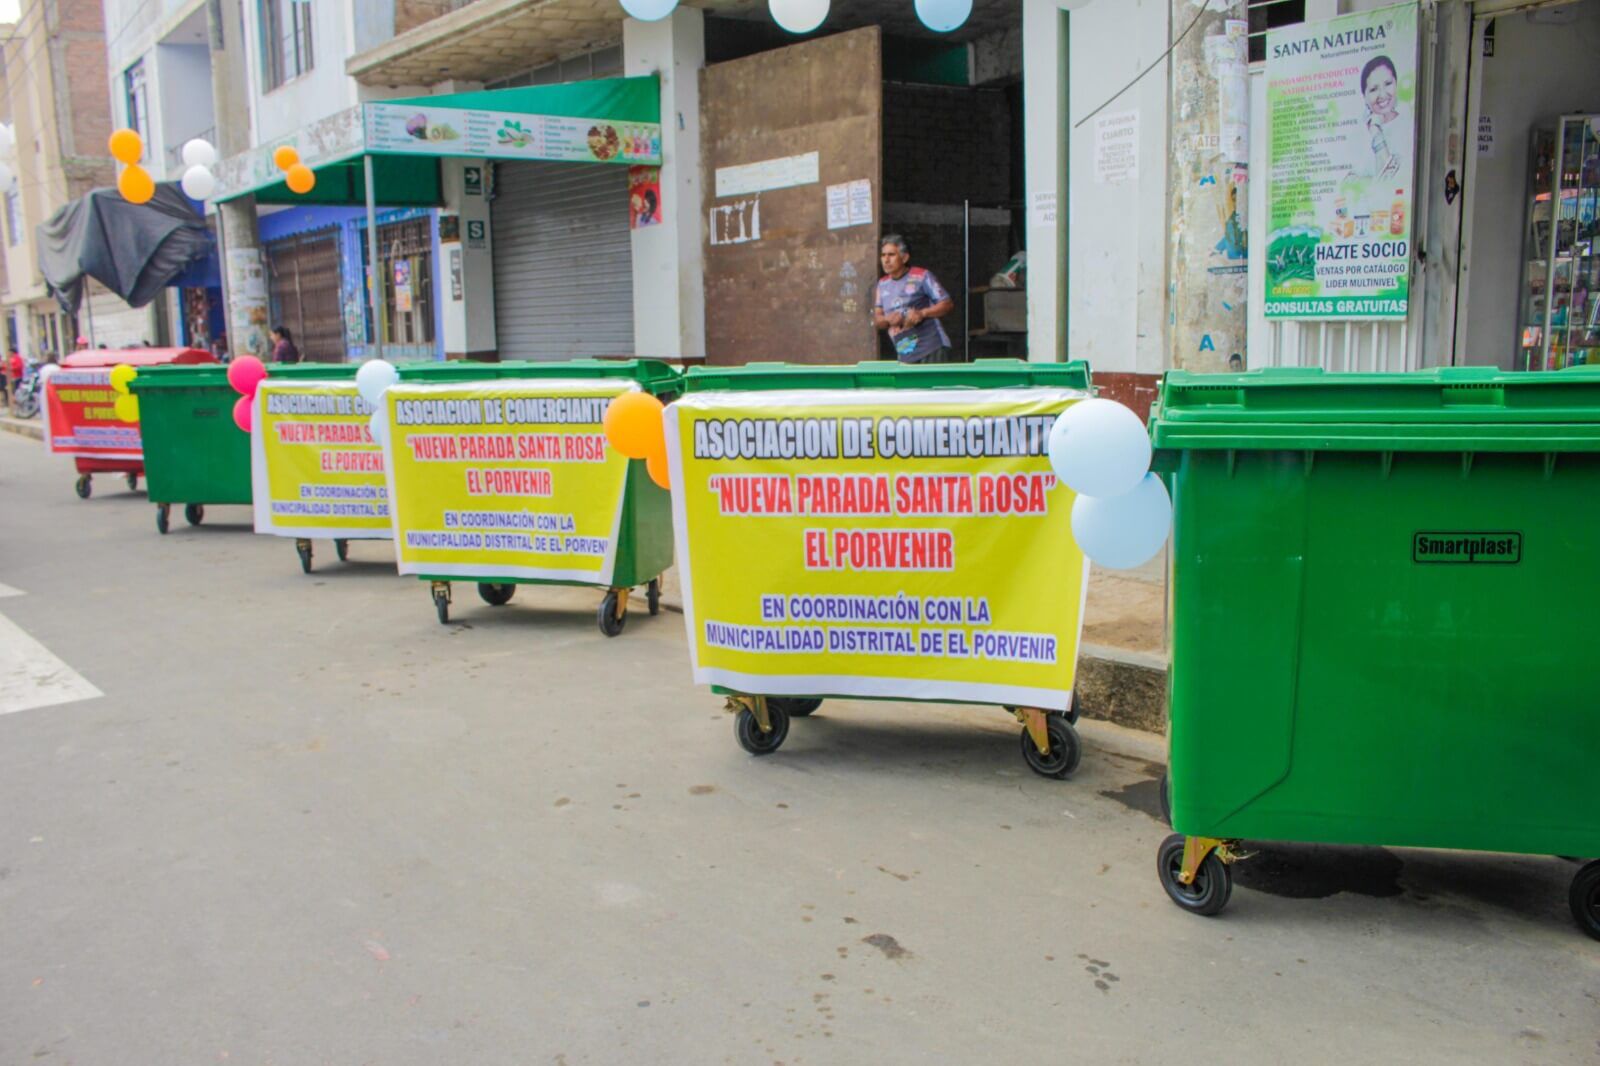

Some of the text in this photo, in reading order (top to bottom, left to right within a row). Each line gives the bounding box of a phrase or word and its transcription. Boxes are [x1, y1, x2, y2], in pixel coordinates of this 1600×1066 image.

[1273, 25, 1386, 59] SANTA NATURA
[471, 222, 483, 238] S
[1316, 242, 1407, 260] HAZTE SOCIO
[1316, 266, 1344, 276] VENTAS
[1346, 265, 1361, 274] POR
[1350, 278, 1396, 288] MULTINIVEL
[1264, 300, 1407, 313] CONSULTAS GRATUITAS
[396, 399, 482, 425] ASOCIACION
[484, 399, 503, 424] DE
[318, 423, 363, 443] PARADA
[694, 418, 838, 459] ASOCIACION
[841, 417, 873, 458] DE
[460, 435, 514, 460] PARADA
[518, 435, 561, 460] SANTA
[322, 452, 333, 471] EL
[301, 486, 311, 497] EN
[467, 470, 551, 495] EL PORVENIR
[710, 474, 1056, 513] “NUEVA PARADA SANTA ROSA”
[333, 503, 375, 516] DISTRITAL
[445, 509, 574, 530] EN COORDINACIÓN CON LA
[407, 533, 482, 548] MUNICIPALIDAD
[485, 535, 533, 550] DISTRITAL
[535, 537, 546, 551] DE
[549, 537, 561, 551] EL
[806, 531, 953, 569] EL PORVENIR
[1418, 537, 1514, 562] Smartplast
[762, 594, 989, 622] EN COORDINACIÓN CON LA
[706, 622, 1056, 661] MUNICIPALIDAD DISTRITAL DE EL PORVENIR
